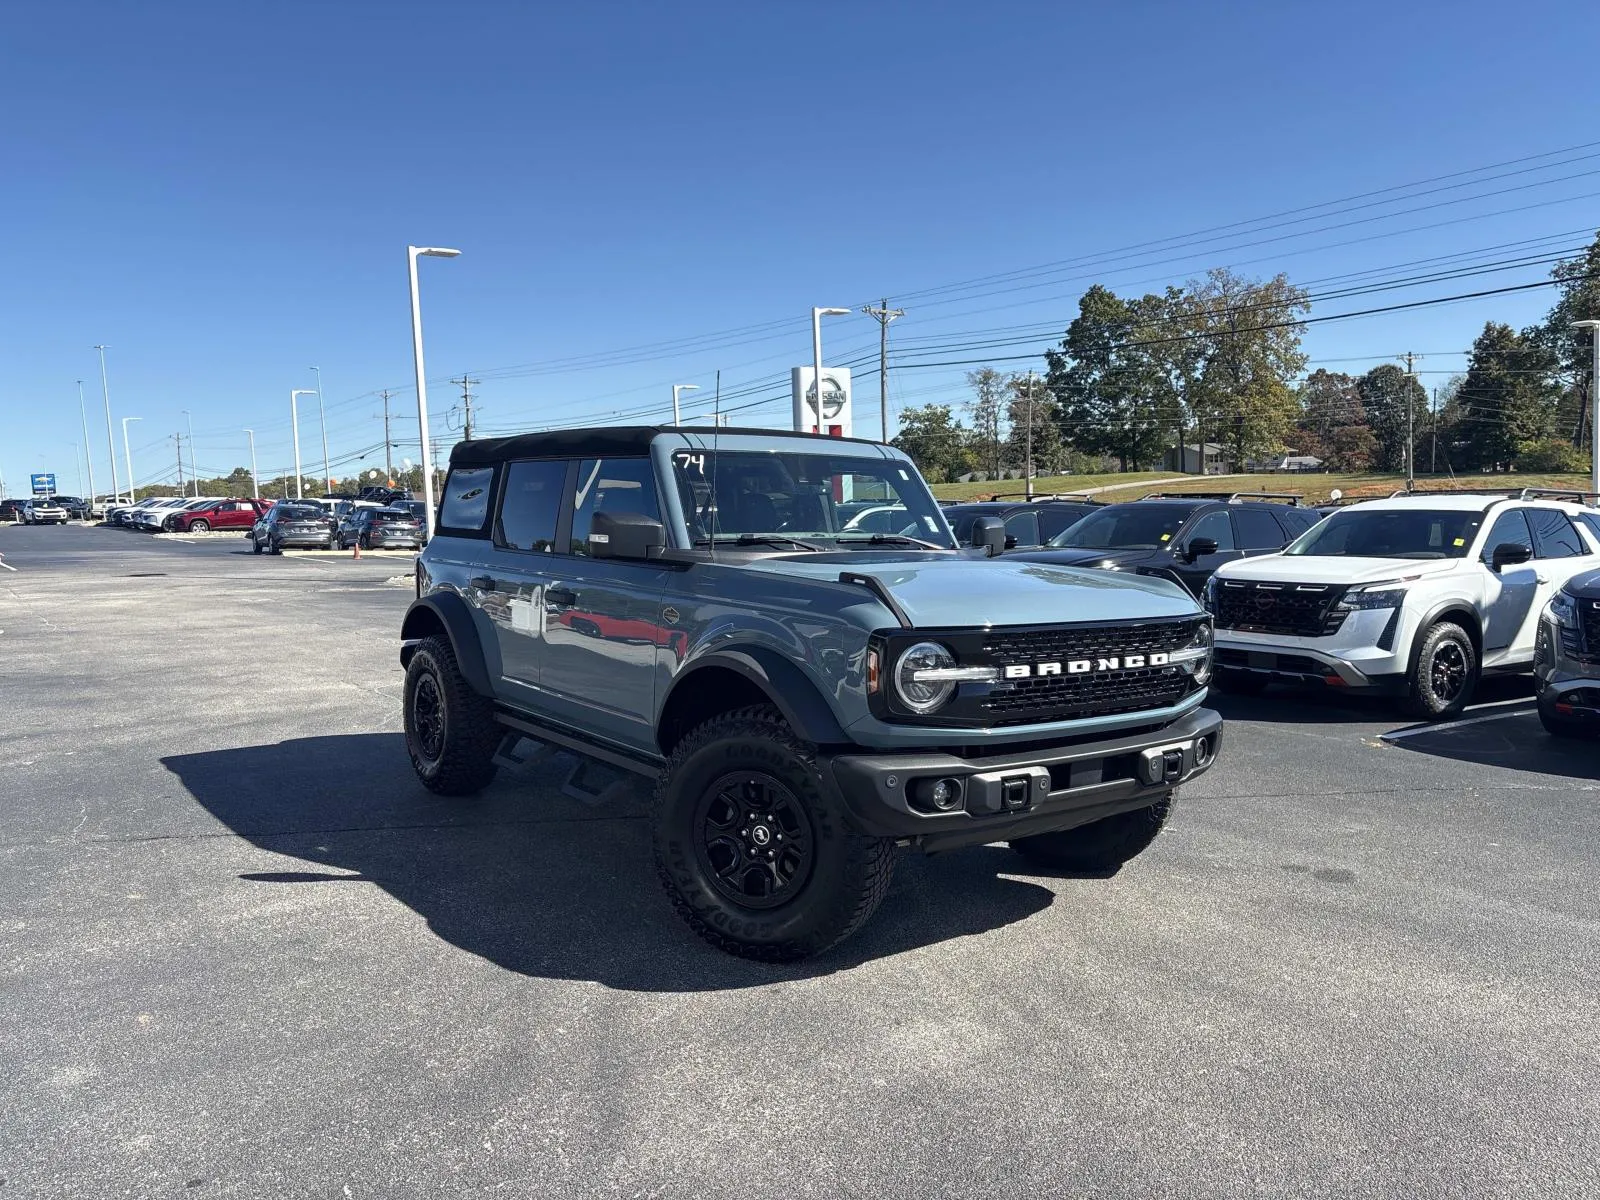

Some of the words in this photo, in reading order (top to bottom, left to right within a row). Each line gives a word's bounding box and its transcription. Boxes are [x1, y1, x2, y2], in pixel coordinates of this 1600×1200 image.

[811, 392, 843, 400] NSSAN
[676, 453, 704, 474] 74
[1005, 653, 1169, 678] BRONCO
